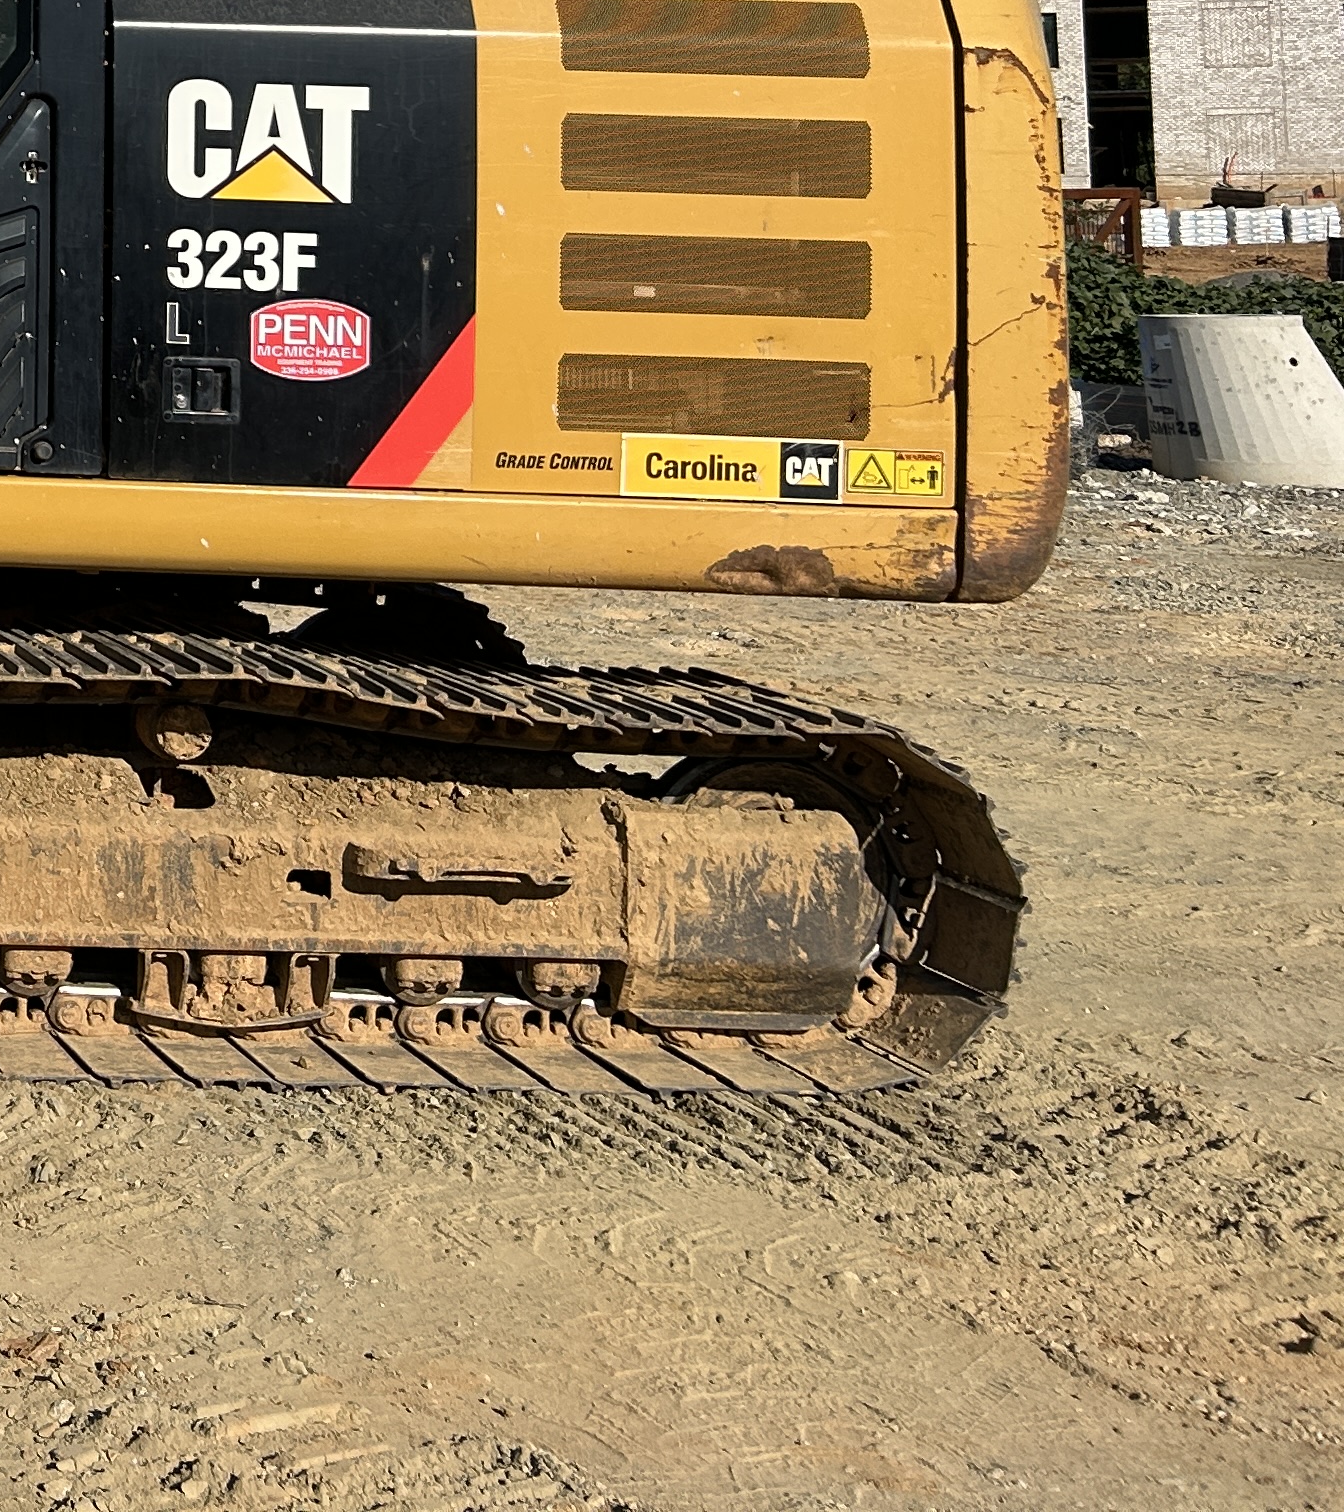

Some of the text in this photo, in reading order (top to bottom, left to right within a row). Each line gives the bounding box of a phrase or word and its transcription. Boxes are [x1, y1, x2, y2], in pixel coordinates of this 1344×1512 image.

[167, 79, 370, 204] CAT
[166, 229, 318, 292] 323F
[166, 302, 190, 345] L
[258, 313, 362, 347] PENN
[257, 345, 363, 359] MCMICHAEL
[495, 451, 614, 472] GRADE CONTROL
[645, 452, 758, 483] Carolina
